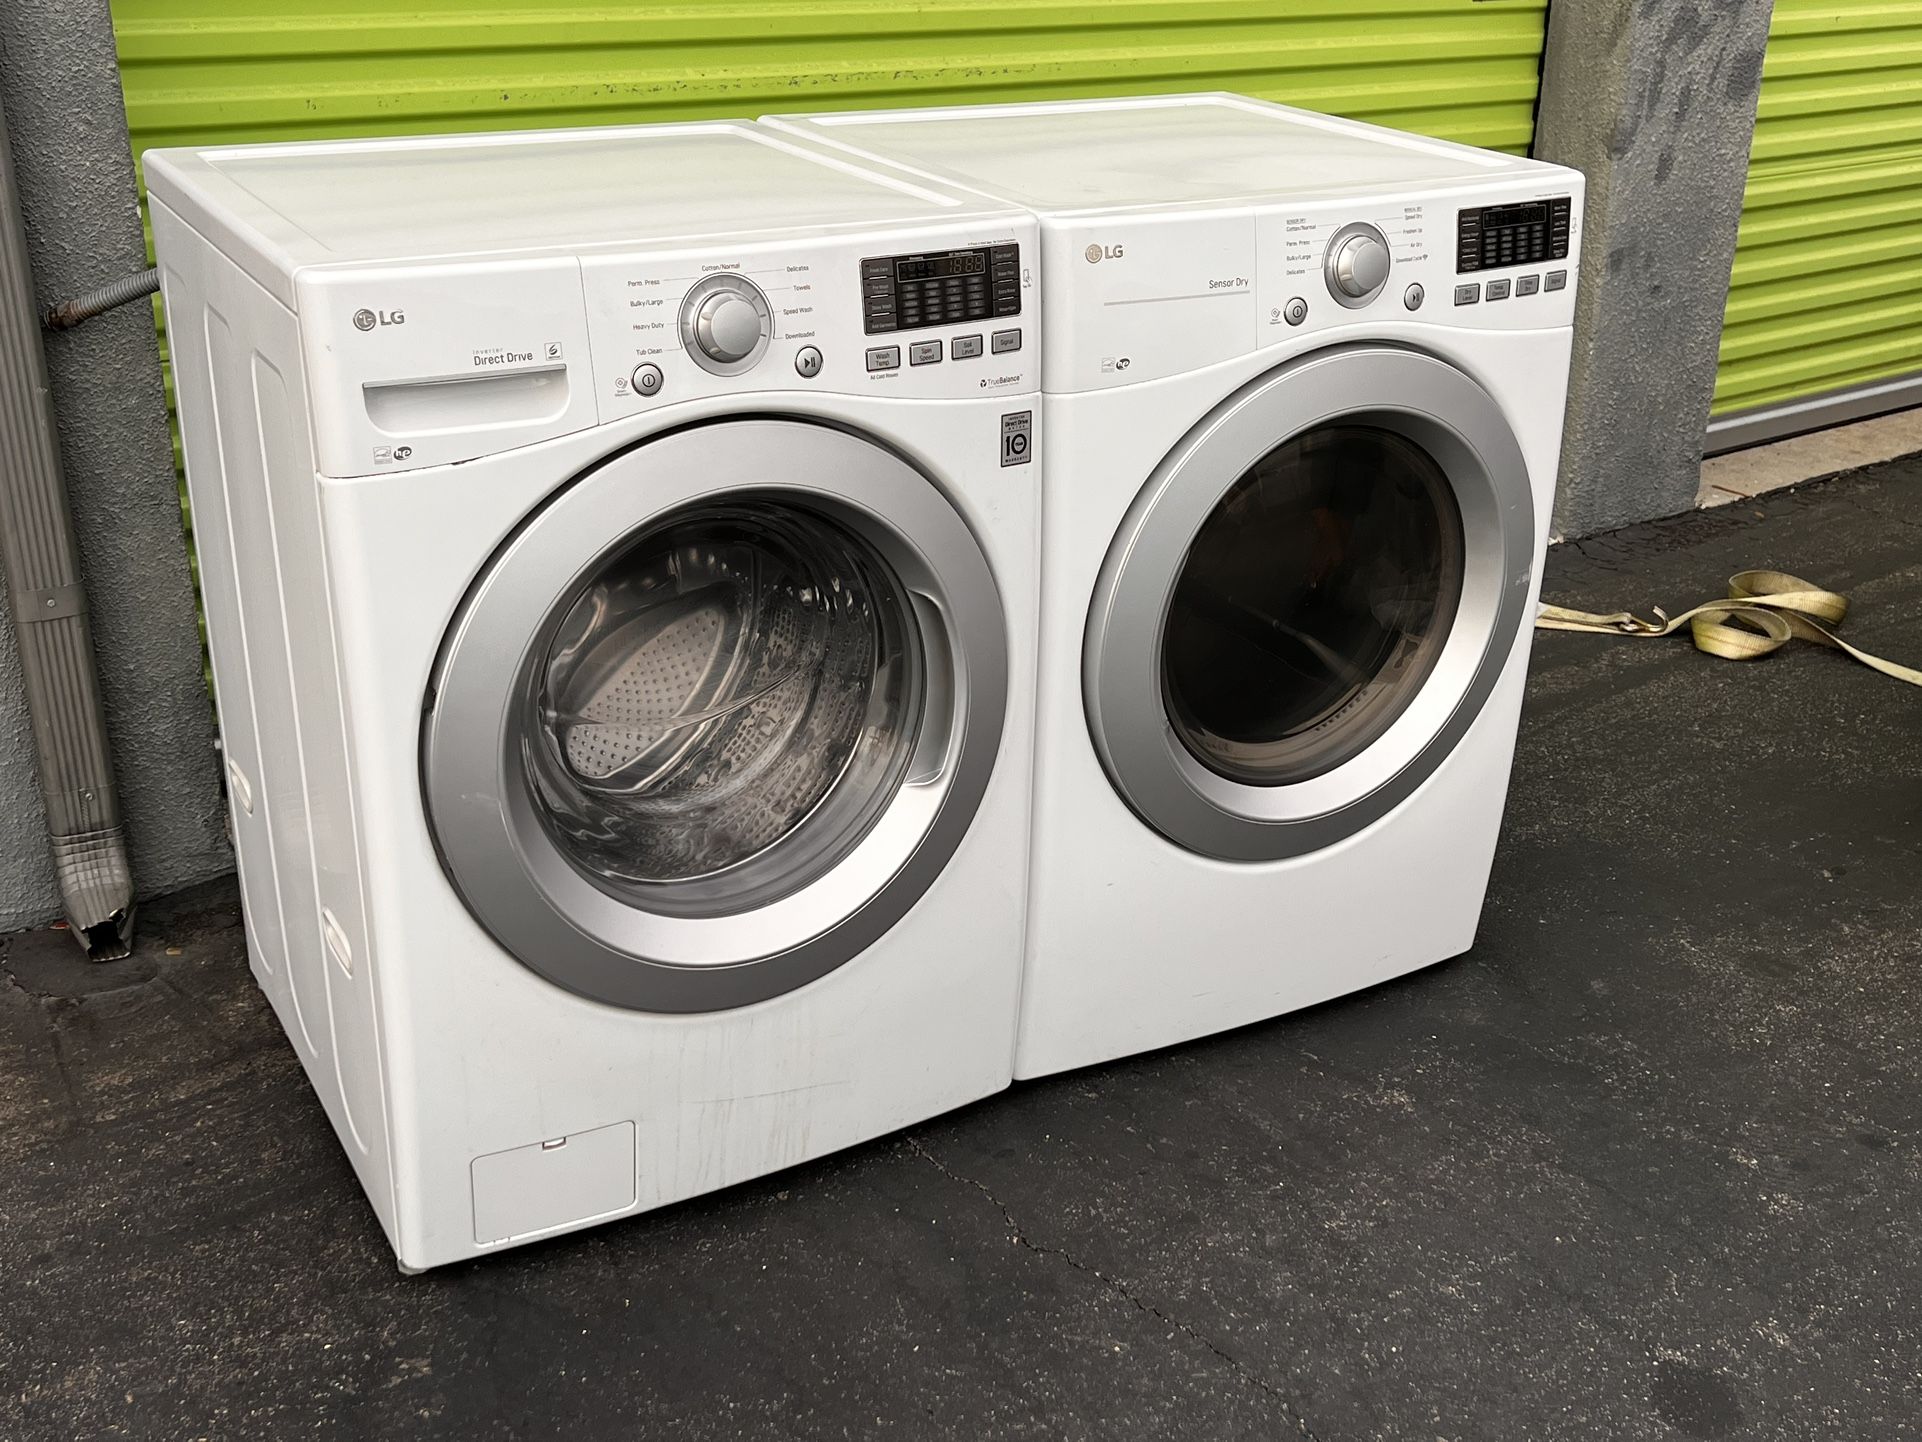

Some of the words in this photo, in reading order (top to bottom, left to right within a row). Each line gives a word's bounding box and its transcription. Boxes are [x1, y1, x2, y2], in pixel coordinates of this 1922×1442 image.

[1104, 244, 1124, 259] LG
[702, 262, 740, 272] Cotton/Normal
[1208, 279, 1234, 289] Sensor
[1236, 277, 1248, 288] Dry
[630, 300, 664, 308] Bulky/Large
[379, 310, 404, 326] LG
[632, 323, 650, 331] Heavy
[652, 322, 664, 330] Duty
[784, 331, 816, 340] Downloaded
[474, 354, 504, 366] Direct
[506, 352, 534, 362] Drive
[1006, 433, 1027, 456] 10
